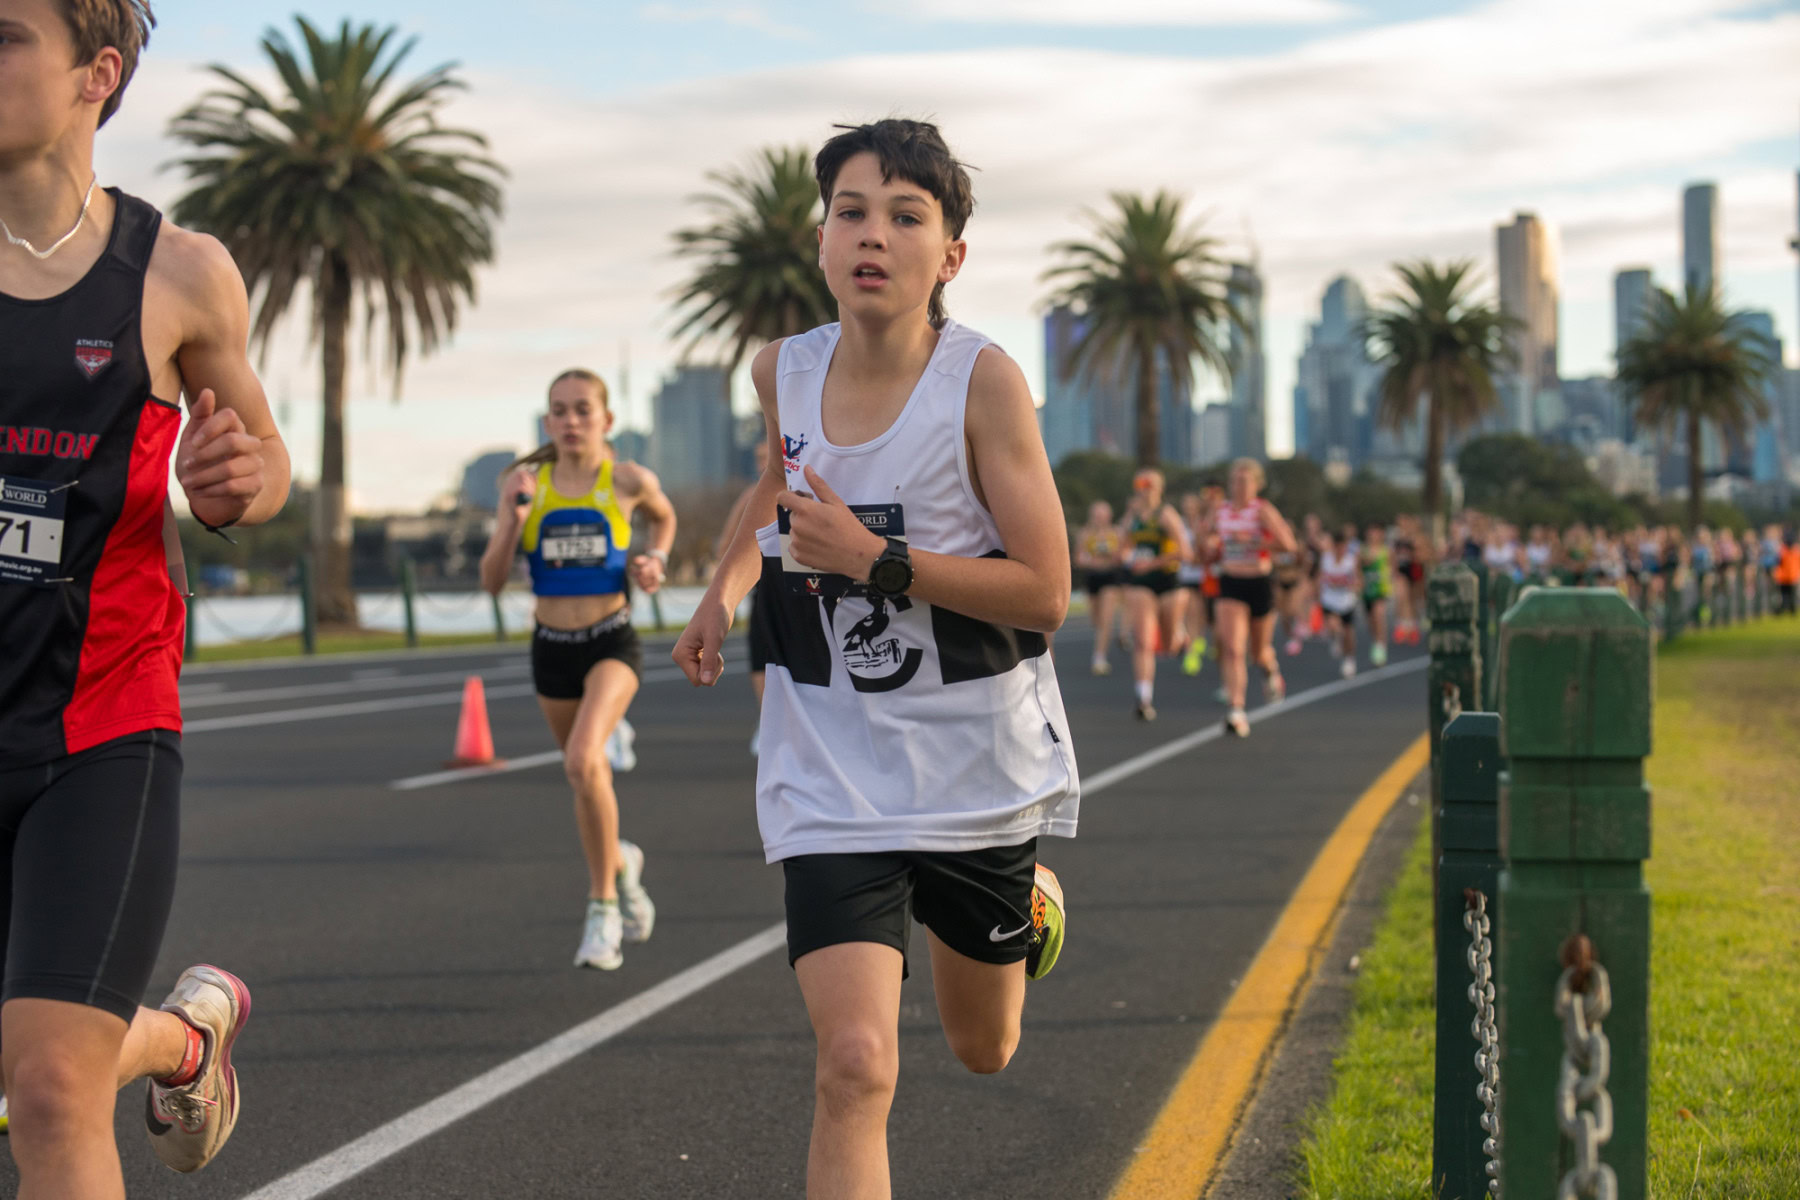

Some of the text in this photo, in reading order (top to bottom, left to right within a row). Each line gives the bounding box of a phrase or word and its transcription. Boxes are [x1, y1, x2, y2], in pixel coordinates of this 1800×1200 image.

[76, 338, 114, 349] ATHLETICS
[783, 457, 801, 472] etics
[4, 489, 47, 504] WORLD
[857, 515, 888, 525] ORLD
